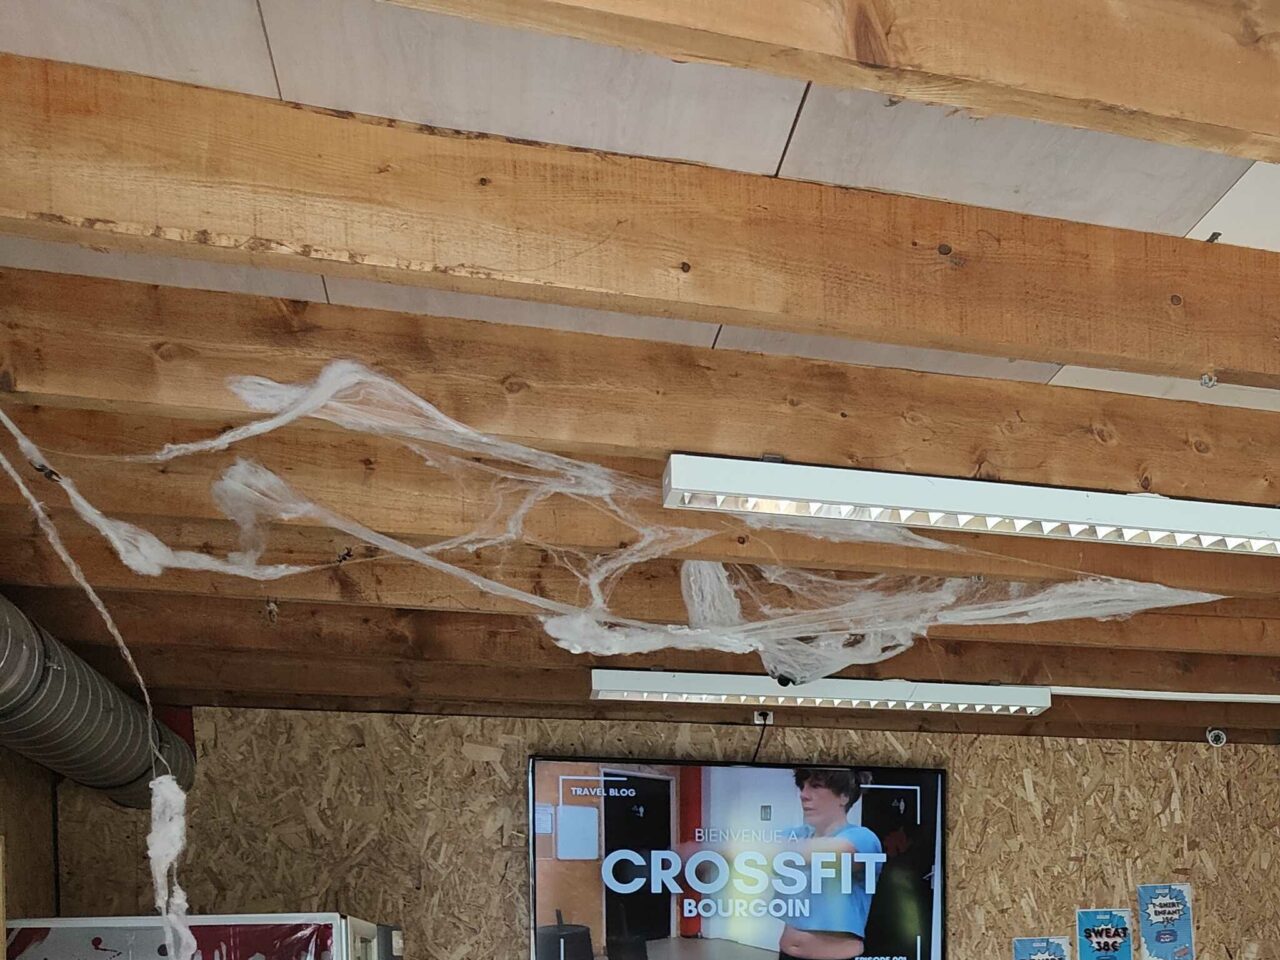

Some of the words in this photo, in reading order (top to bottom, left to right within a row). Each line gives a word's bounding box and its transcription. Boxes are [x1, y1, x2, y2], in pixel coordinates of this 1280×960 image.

[571, 787, 607, 797] TRAVEL
[608, 788, 636, 797] BLOG
[694, 828, 783, 843] BIENVENUE
[601, 849, 887, 895] CROSSFIT
[682, 898, 810, 919] BOURGOIN
[1152, 901, 1181, 909] T-SHIRT
[1083, 926, 1129, 939] SWEAT
[1094, 940, 1120, 952] 38€
